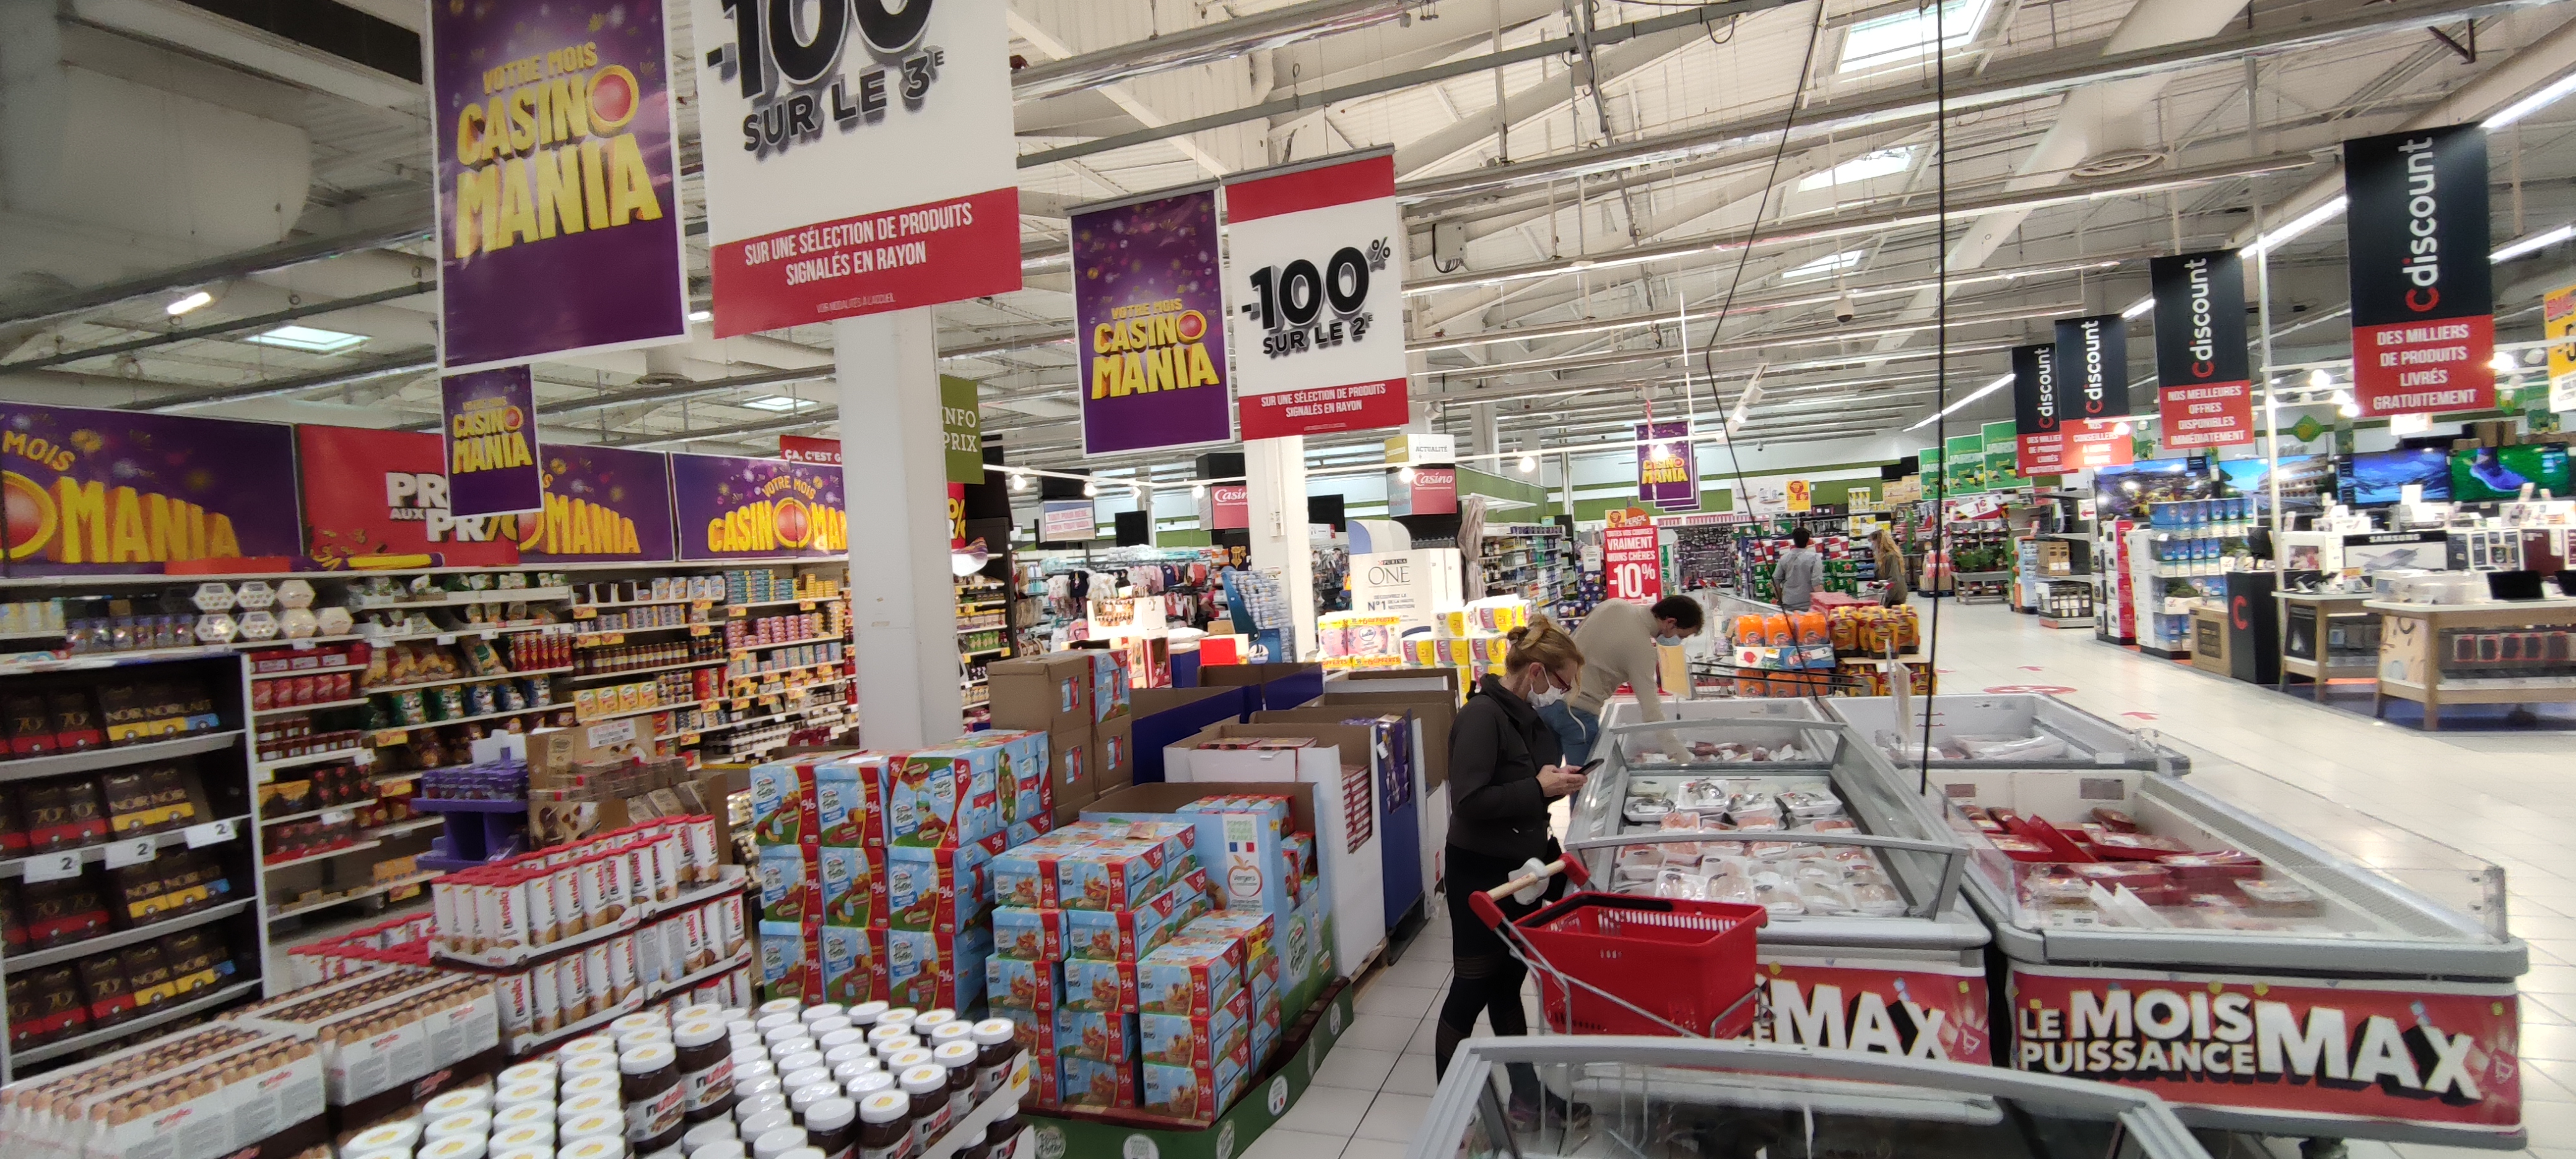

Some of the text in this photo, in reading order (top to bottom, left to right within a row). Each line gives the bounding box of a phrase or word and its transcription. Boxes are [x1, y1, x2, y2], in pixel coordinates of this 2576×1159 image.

[483, 41, 598, 97] VOTRE MOIS
[457, 64, 639, 167] CASINO
[744, 94, 816, 151] SUR
[832, 70, 887, 121] LE
[455, 132, 663, 258] MANIA
[744, 202, 973, 266] SUR UNE SÉLECTION DE PRODUITS
[786, 241, 927, 286] SIGNALÉS EN RAYON
[1111, 298, 1183, 320] VOTRE MOIS
[1094, 309, 1207, 354] CASINO
[1263, 331, 1304, 354] SUR
[1315, 322, 1343, 344] LE
[2377, 324, 2468, 346] DES MILLIERS
[2380, 345, 2467, 367] DE PRODUITS
[1091, 342, 1220, 399] MANIA
[2400, 368, 2448, 386] LIVRÉS
[1261, 383, 1386, 407] SUR UNE SÉLECTION DE PRODUITS
[2168, 386, 2242, 401] NOS MEILLEURES
[2373, 388, 2476, 410] GRATUITEMENT
[1286, 399, 1362, 417] SIGNALÉS EN RAYON
[2188, 402, 2222, 414] OFFRES
[453, 406, 523, 438] CASINO
[2178, 416, 2235, 430] DISPONIBLES
[2170, 428, 2244, 445] IMMÉDIATEMENT
[2, 430, 76, 472] MOIS
[453, 432, 533, 474] MANIA
[785, 449, 803, 462] ÇA,
[804, 451, 832, 461] C'EST
[762, 475, 817, 500] VOTRE MOIS
[1413, 472, 1453, 486] Casino
[1642, 467, 1689, 484] MANIA
[389, 508, 426, 519] AUX
[1607, 536, 1653, 550] VRAIMENT
[2369, 534, 2421, 543] SAMSUNG
[1607, 550, 1655, 562] MOINS CHÈRES
[1368, 566, 1410, 585] ONE
[1609, 563, 1655, 597] -10%
[1770, 978, 1946, 1059] MAX
[2019, 1008, 2060, 1040] LE
[2070, 989, 2253, 1042] MOIS
[2019, 1040, 2255, 1074] PUISSANCE
[2254, 1000, 2482, 1100] MAX
